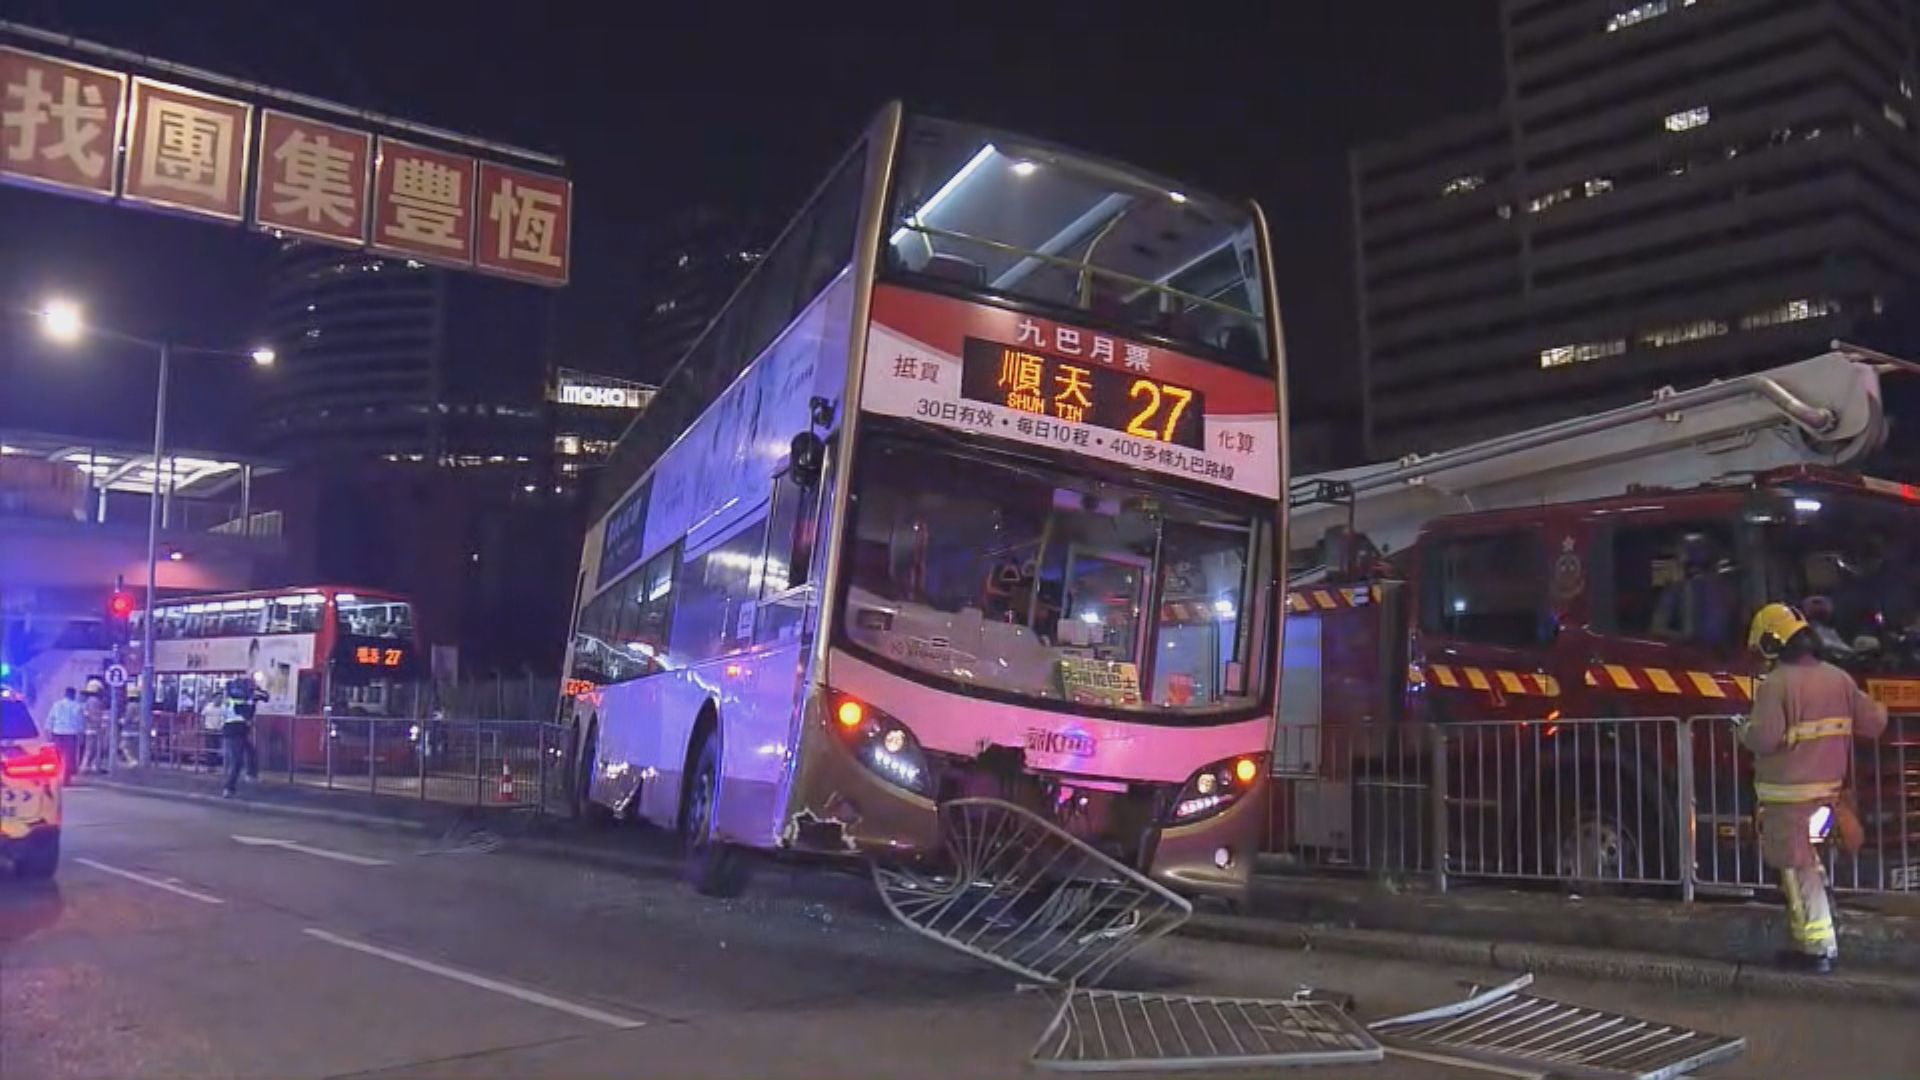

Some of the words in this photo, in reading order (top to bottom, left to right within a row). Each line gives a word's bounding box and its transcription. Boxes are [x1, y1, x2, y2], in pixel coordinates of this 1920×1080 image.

[1017, 319, 1151, 372] 九巴月票
[892, 353, 940, 384] 抵買
[561, 385, 625, 407] MOKO
[998, 350, 1092, 407] 順天
[1126, 379, 1193, 442] 27
[1006, 391, 1045, 415] SHUN
[1055, 402, 1082, 423] TIN
[916, 397, 995, 428] 30日有效
[1016, 415, 1090, 447] 每日10程
[1109, 437, 1235, 481] 400多條九巴路線
[1217, 429, 1256, 455] 化算
[384, 648, 402, 666] 27
